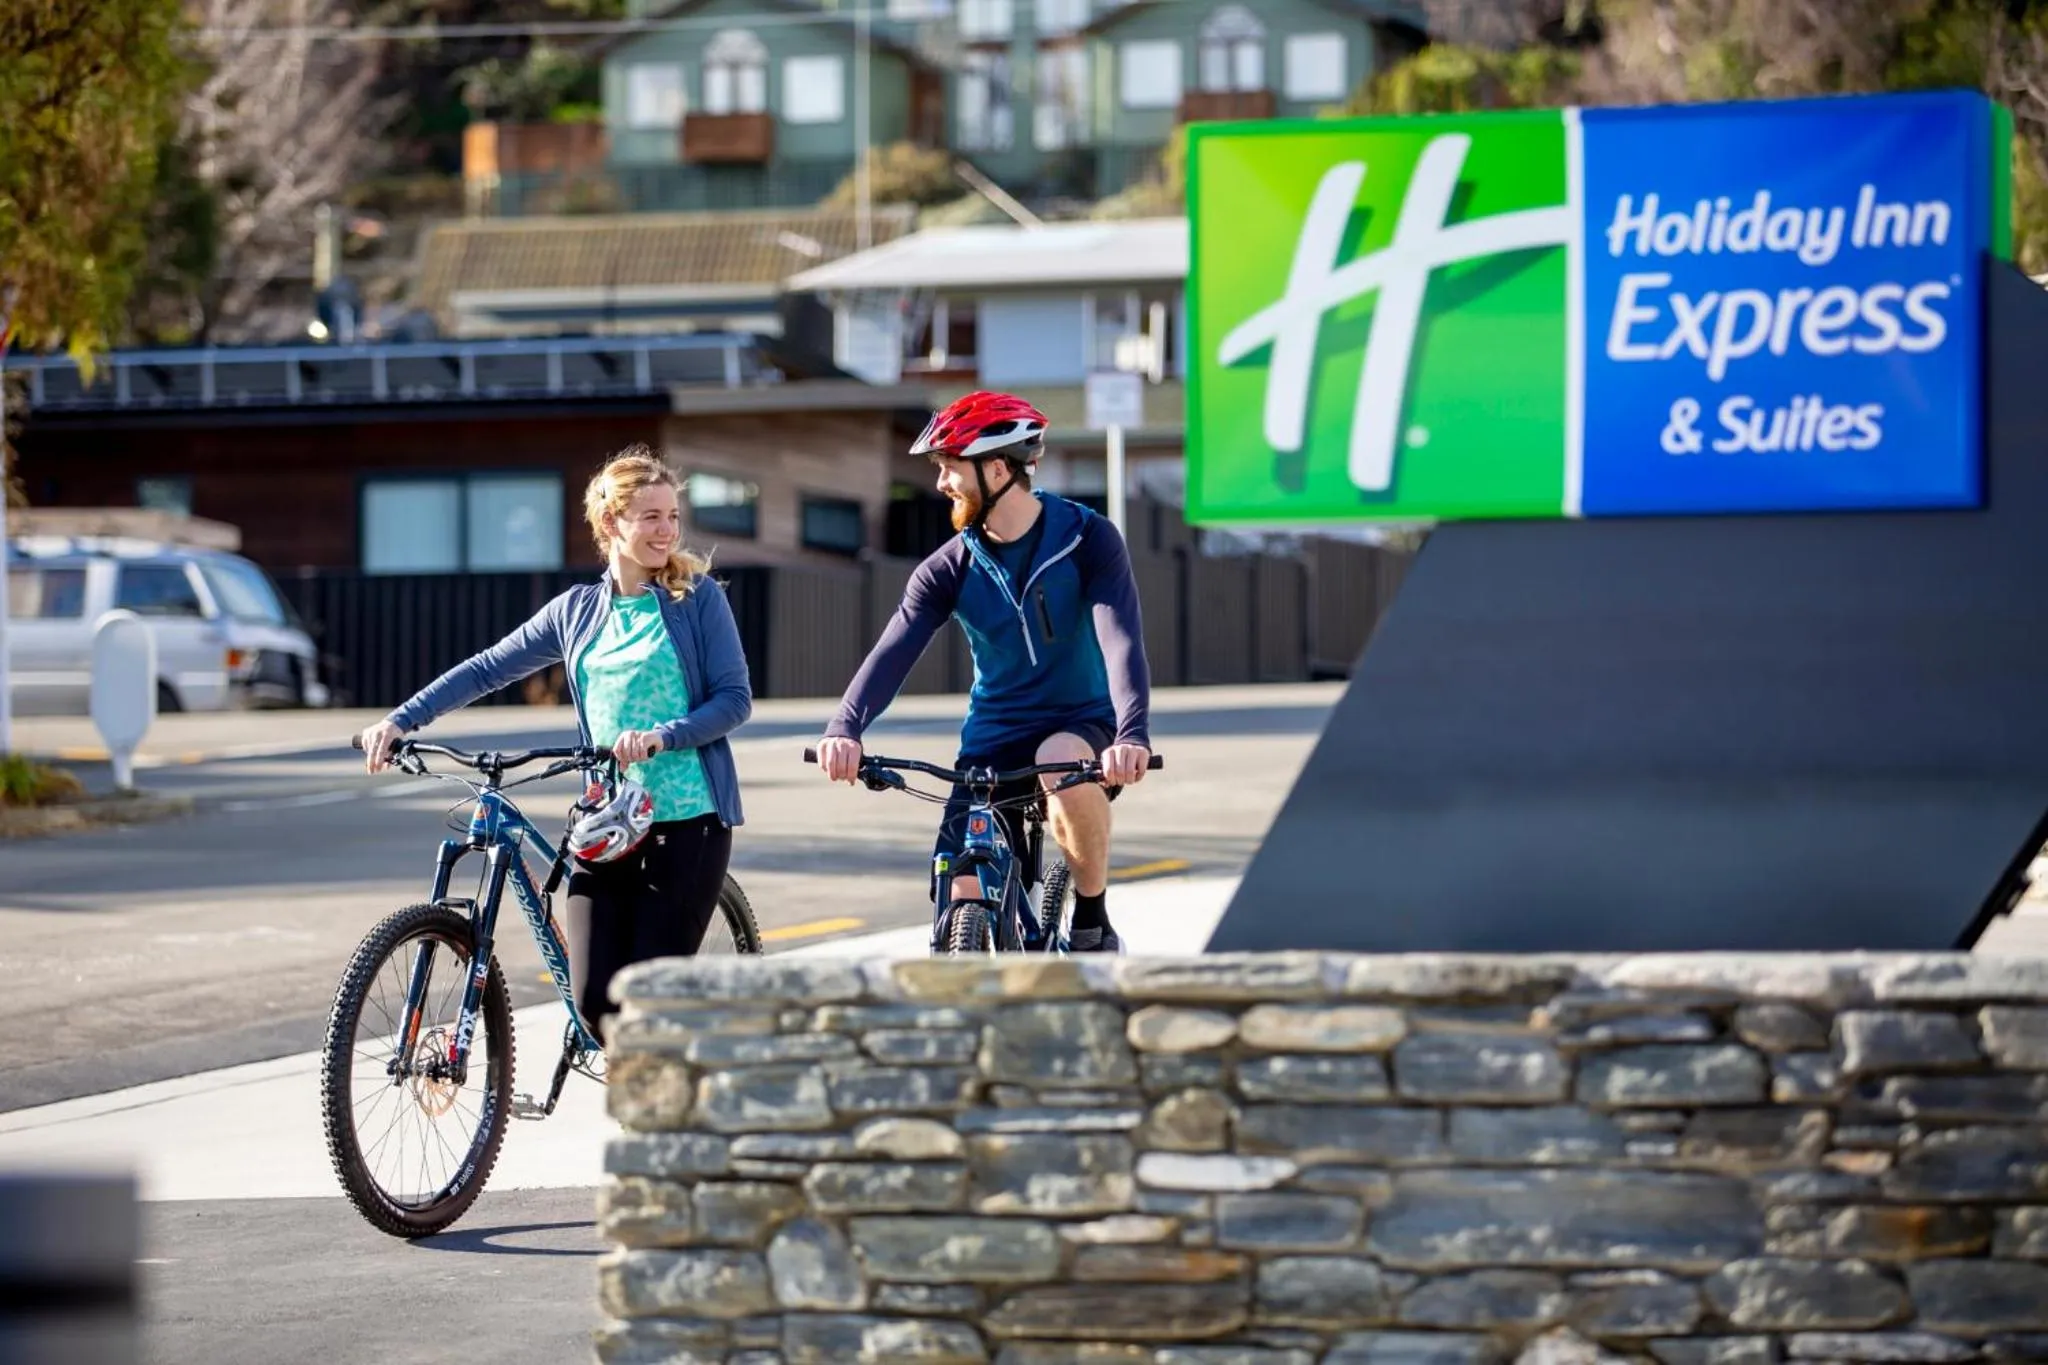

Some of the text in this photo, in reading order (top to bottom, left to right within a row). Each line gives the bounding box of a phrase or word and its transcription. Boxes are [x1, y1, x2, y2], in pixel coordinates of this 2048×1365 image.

[1606, 184, 1951, 266] Holiday Inn
[1606, 272, 1950, 382] Express
[1660, 395, 1883, 455] & Suites
[456, 1007, 478, 1050] FOX
